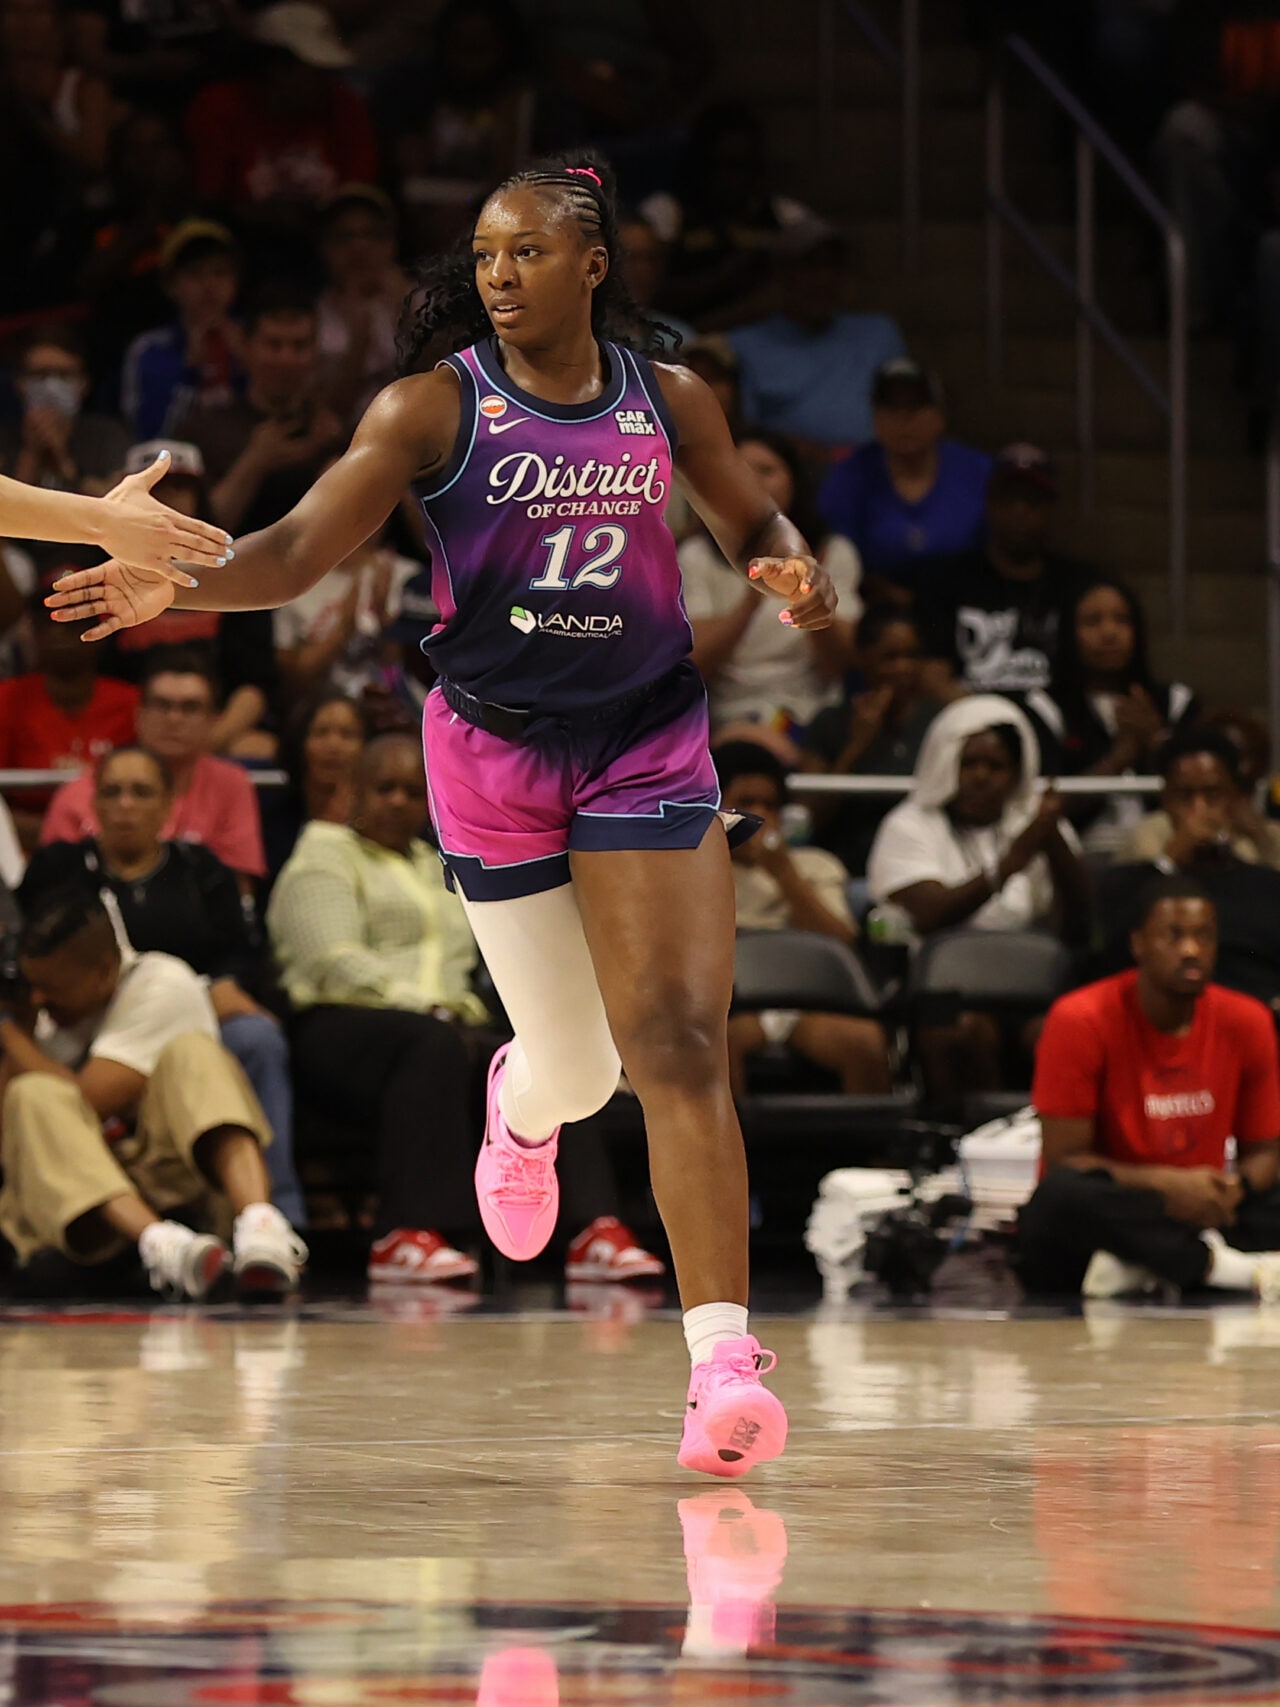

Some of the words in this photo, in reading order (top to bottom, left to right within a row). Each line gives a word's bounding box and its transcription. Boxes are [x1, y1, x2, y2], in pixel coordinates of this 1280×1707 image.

[614, 410, 648, 424] CAR
[618, 421, 657, 436] max
[485, 451, 666, 505] District
[526, 504, 555, 519] OF
[556, 500, 642, 516] CHANGE
[528, 522, 629, 591] 12
[537, 612, 624, 632] VANDA
